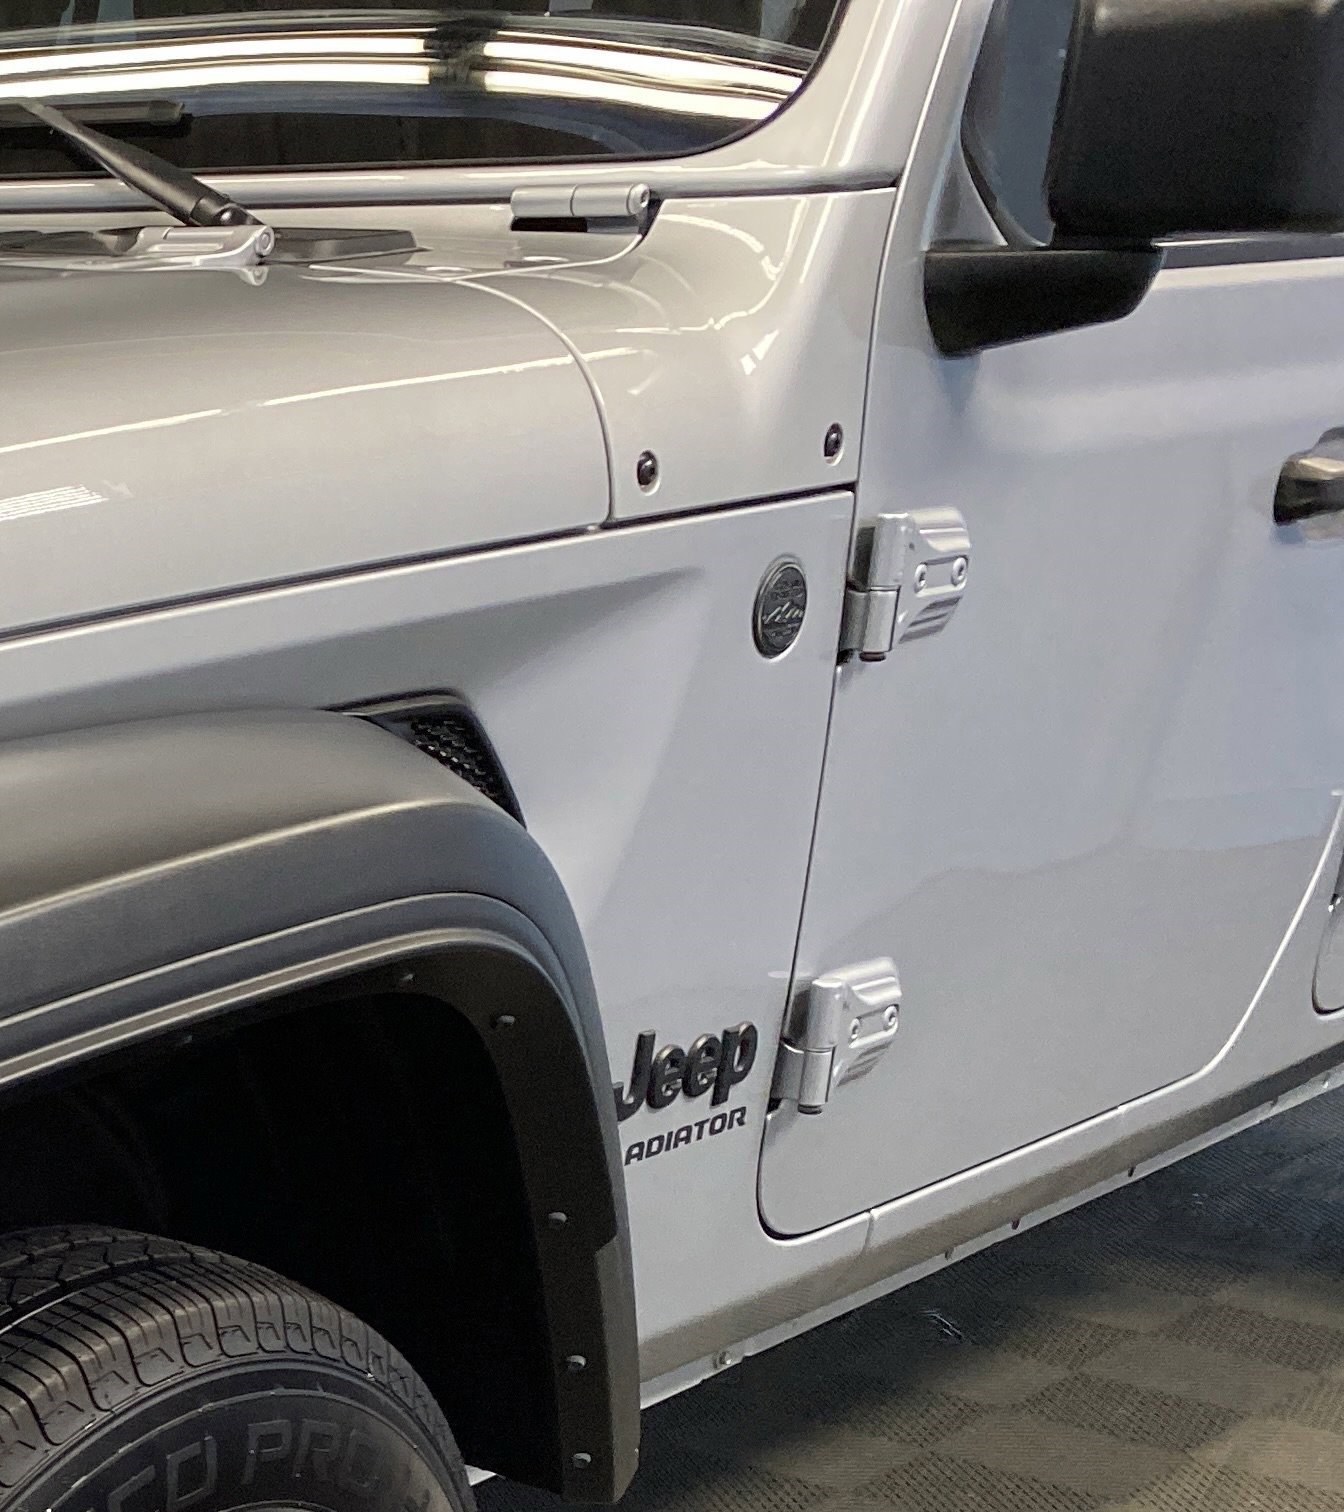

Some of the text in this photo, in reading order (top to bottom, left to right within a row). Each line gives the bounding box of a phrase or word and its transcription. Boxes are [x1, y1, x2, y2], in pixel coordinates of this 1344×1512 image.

[612, 1020, 758, 1122] Jeep
[623, 1106, 747, 1166] ADIATOR
[240, 1417, 385, 1494] PRO
